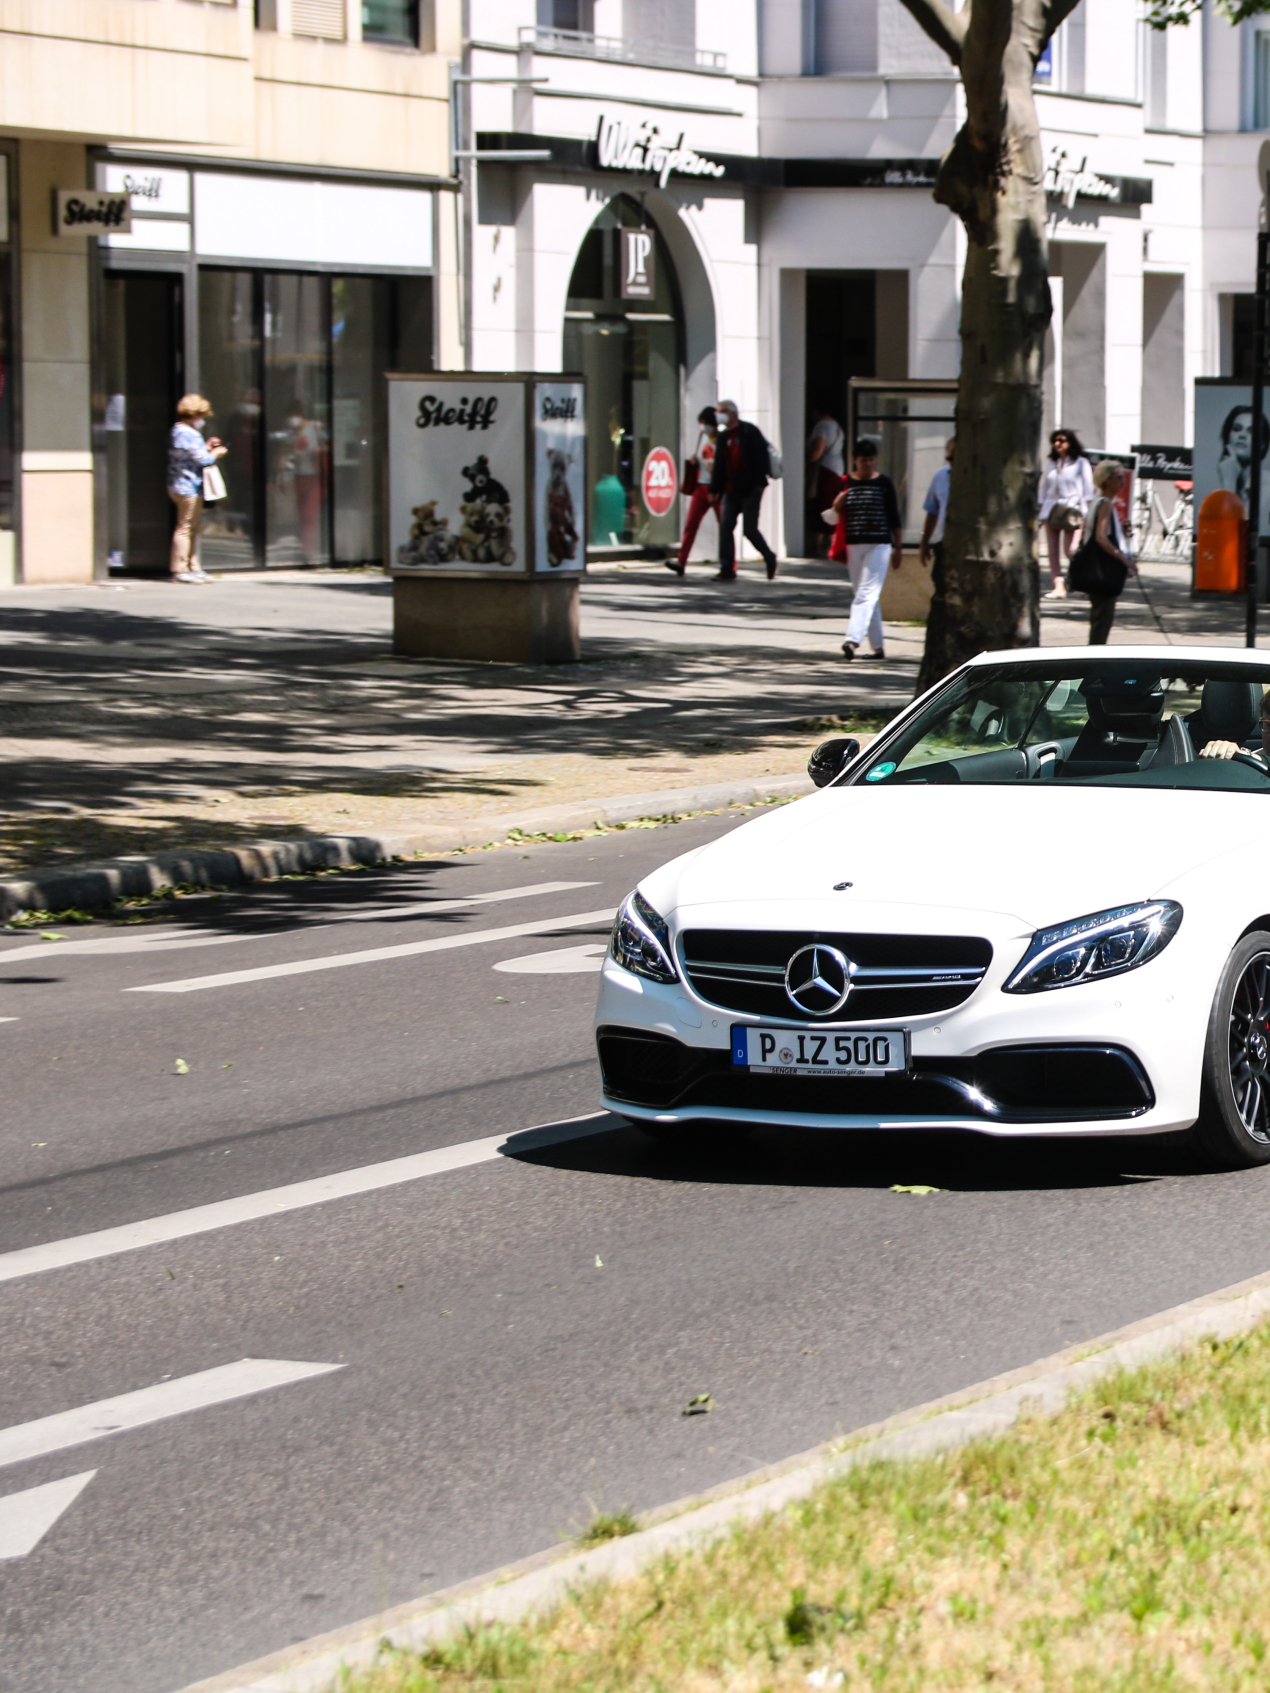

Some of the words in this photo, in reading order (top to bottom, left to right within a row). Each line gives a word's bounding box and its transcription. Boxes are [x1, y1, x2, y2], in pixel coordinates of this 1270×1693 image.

[64, 197, 127, 227] Steiff
[626, 231, 652, 285] JP
[414, 394, 499, 432] Steiff
[541, 396, 577, 421] Steiff
[737, 1049, 744, 1058] D
[759, 1032, 776, 1062] P
[796, 1034, 829, 1065] IZ
[834, 1035, 891, 1066] 500
[771, 1067, 798, 1075] SENGER
[807, 1068, 866, 1077] www.auto-senger.de
